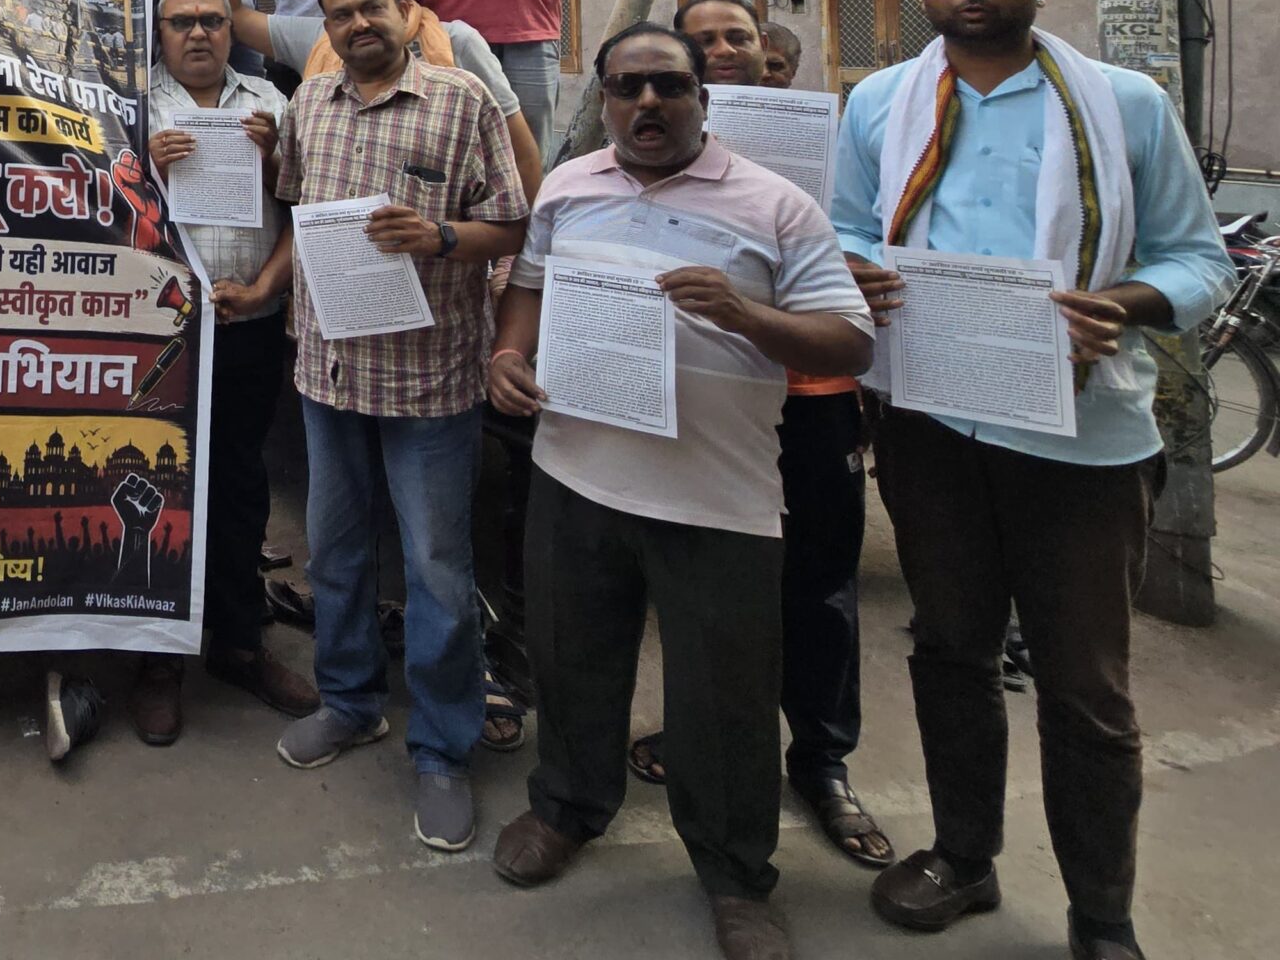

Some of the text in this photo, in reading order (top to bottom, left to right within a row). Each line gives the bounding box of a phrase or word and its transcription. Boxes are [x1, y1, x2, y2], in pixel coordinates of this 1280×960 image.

[26, 55, 66, 102] रेल
[16, 108, 48, 136] का
[51, 112, 93, 146] कार्य
[10, 244, 46, 274] यही
[50, 253, 117, 277] आवाज
[0, 593, 73, 612] #JanAndolan
[85, 593, 175, 613] #VikasKiAwaaz
